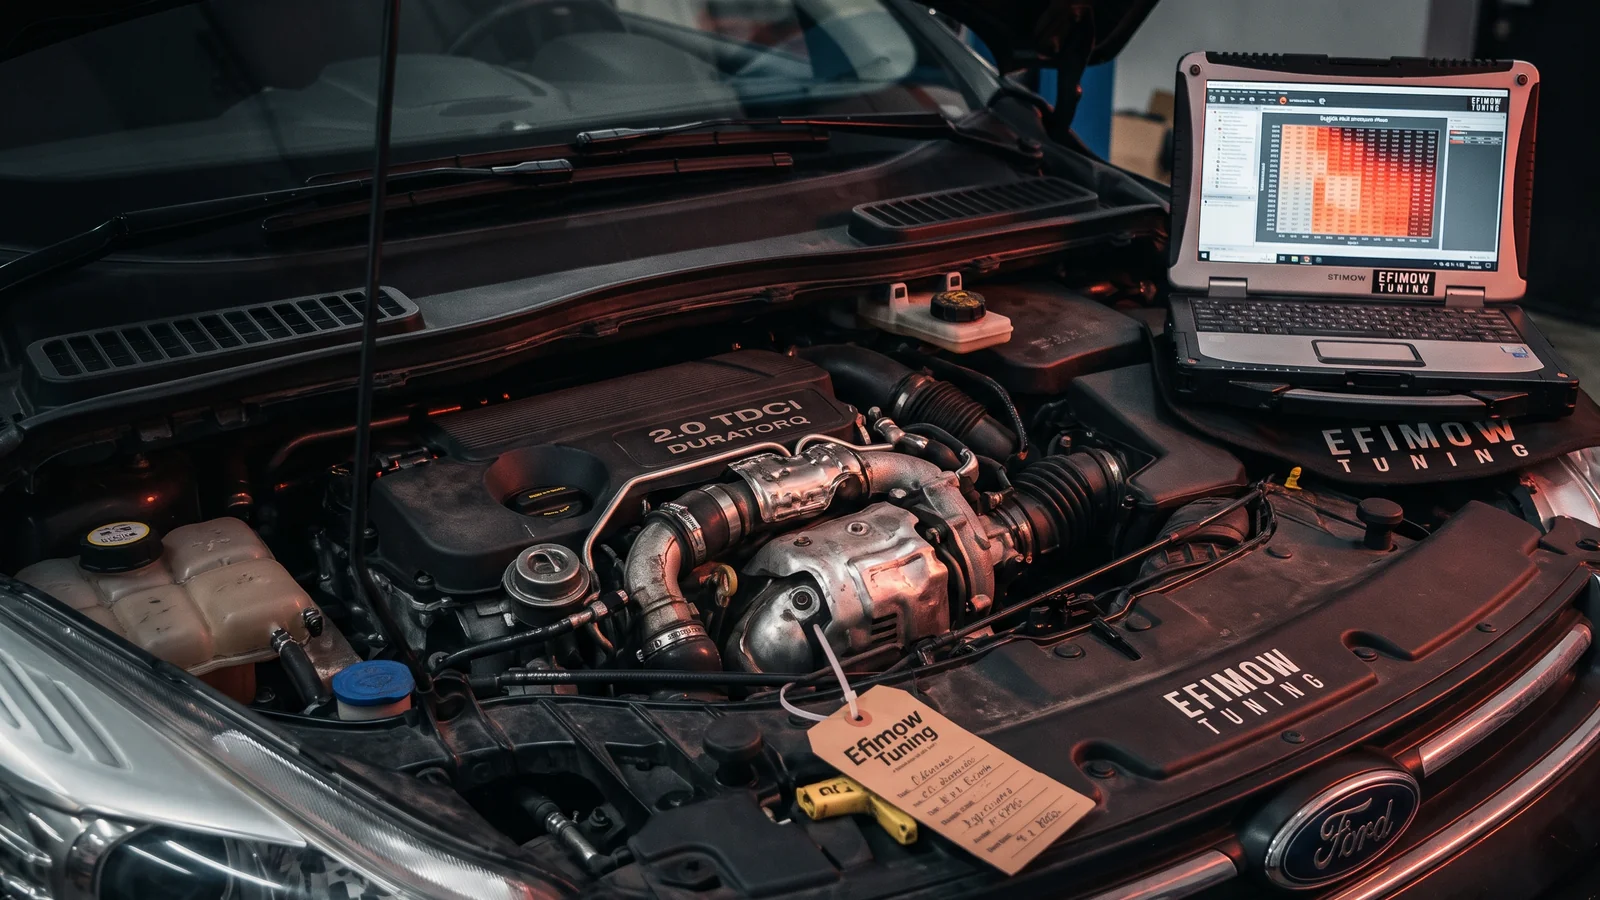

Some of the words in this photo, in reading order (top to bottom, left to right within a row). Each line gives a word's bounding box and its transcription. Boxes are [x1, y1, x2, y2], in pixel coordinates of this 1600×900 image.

[1471, 97, 1501, 105] EFIMOW
[1471, 104, 1500, 112] TUNING
[1327, 273, 1366, 282] STIMOW
[1378, 271, 1430, 285] EFIMOW
[1379, 283, 1428, 294] TUNING
[648, 421, 706, 444] 2.0
[710, 400, 803, 426] TDCI
[667, 416, 811, 455] DURATORQ
[1321, 419, 1516, 456] EFIMOW
[1337, 444, 1529, 473] TUNING
[1162, 648, 1301, 719] EFIMOW
[1197, 673, 1324, 735] TUNING
[843, 710, 923, 766] Efimow
[874, 726, 939, 767] Tuning
[1313, 797, 1394, 870] Ford
